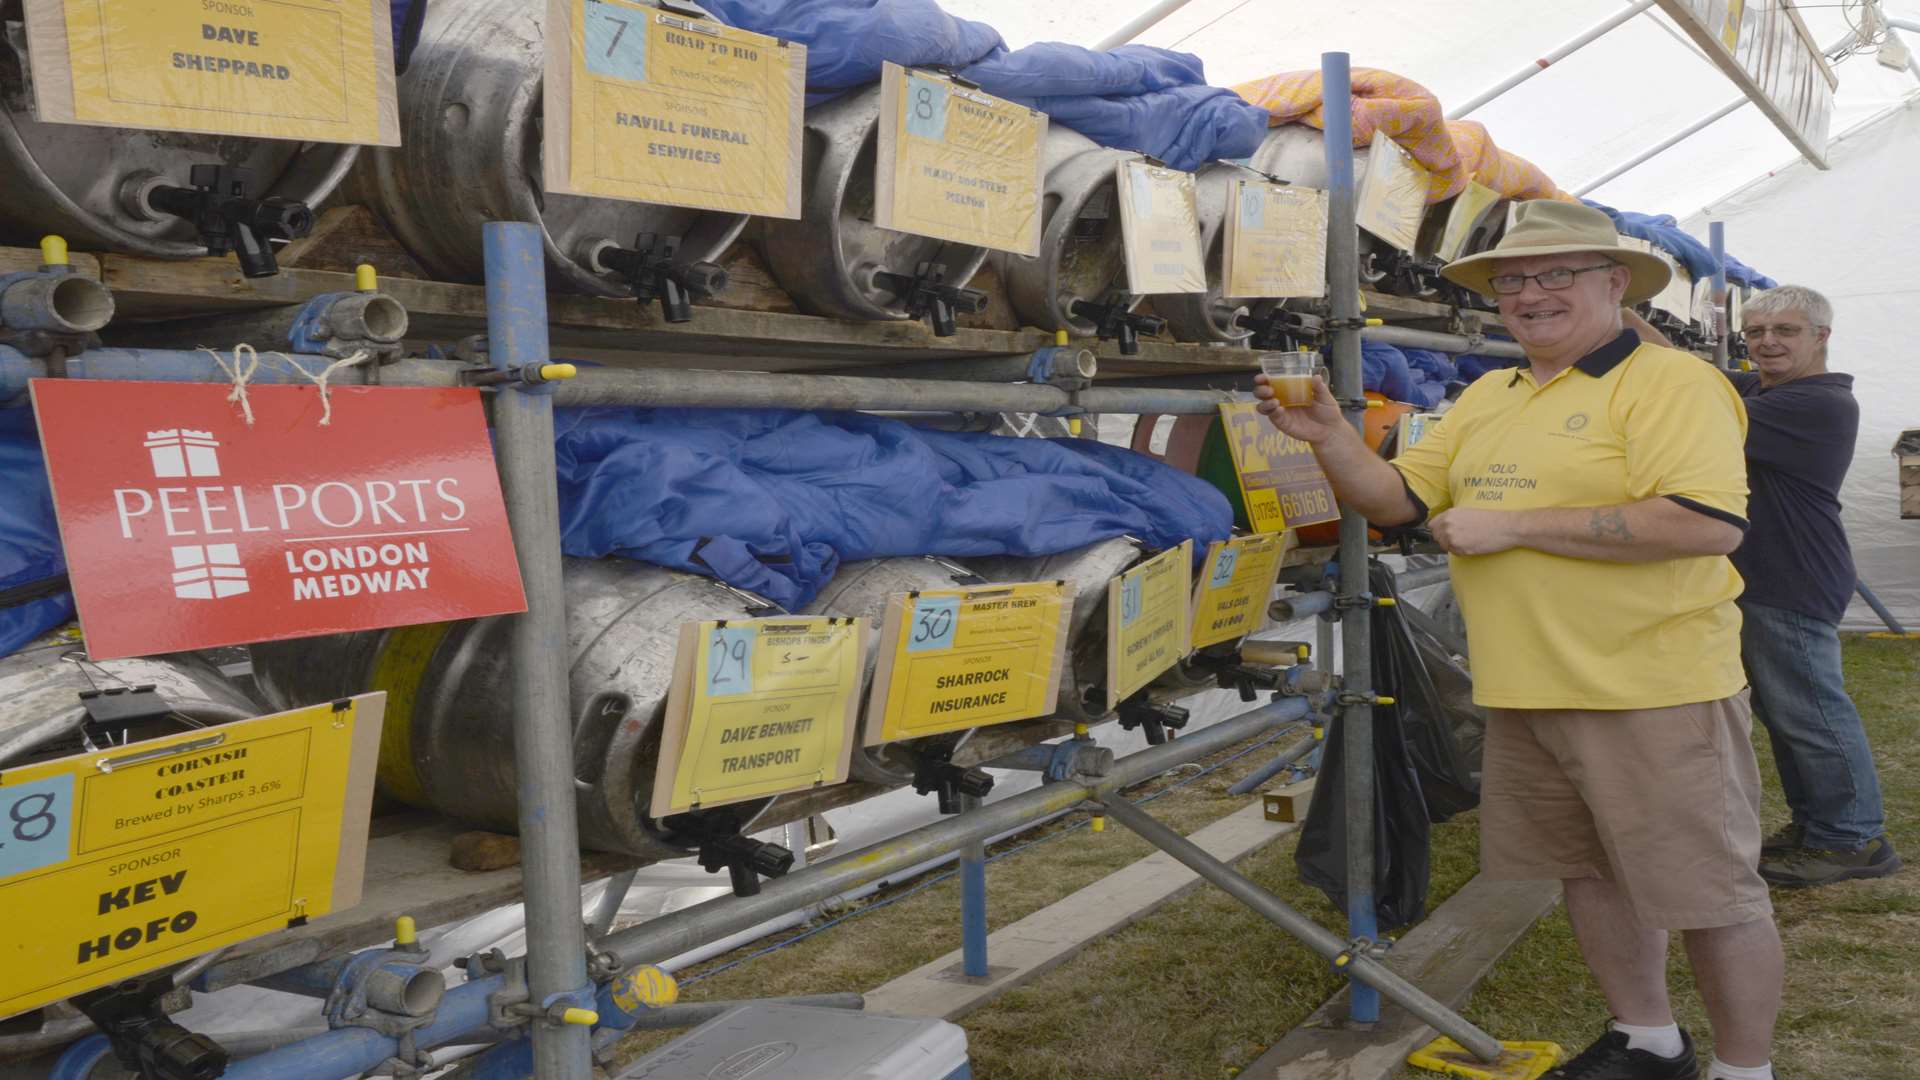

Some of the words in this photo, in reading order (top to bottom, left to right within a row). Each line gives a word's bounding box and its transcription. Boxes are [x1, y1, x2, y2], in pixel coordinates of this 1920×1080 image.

[202, 0, 255, 17] SPONSOR
[202, 24, 259, 46] DAVE
[604, 16, 629, 58] 7
[665, 31, 705, 51] ROAD
[710, 41, 728, 55] TO
[733, 47, 758, 62] RIO
[172, 52, 291, 81] SHEPPARD
[915, 88, 932, 119] 8
[616, 112, 676, 134] HAVILL
[681, 123, 749, 146] FUNERAL
[648, 143, 721, 165] SERVICES
[1475, 490, 1504, 502] INDIA
[285, 541, 429, 574] LONDON
[292, 567, 430, 601] MEDWAY
[972, 600, 1010, 612] MASTER
[914, 608, 953, 643] 30
[712, 635, 748, 684] 29
[936, 668, 1010, 690] SHARROCK
[930, 692, 1008, 715] INSURANCE
[720, 725, 756, 745] DAVE
[759, 718, 815, 740] BENNETT
[156, 748, 249, 778] CORNISH
[721, 748, 802, 774] TRANSPORT
[154, 769, 246, 801] COASTER
[113, 805, 174, 831] Brewed
[177, 799, 195, 816] by
[197, 788, 245, 811] Sharps
[247, 779, 282, 797] 3.6%
[0, 792, 57, 850] 8
[108, 848, 183, 877] SPONSOR
[97, 870, 189, 917] KEV
[77, 910, 199, 966] HOFO
